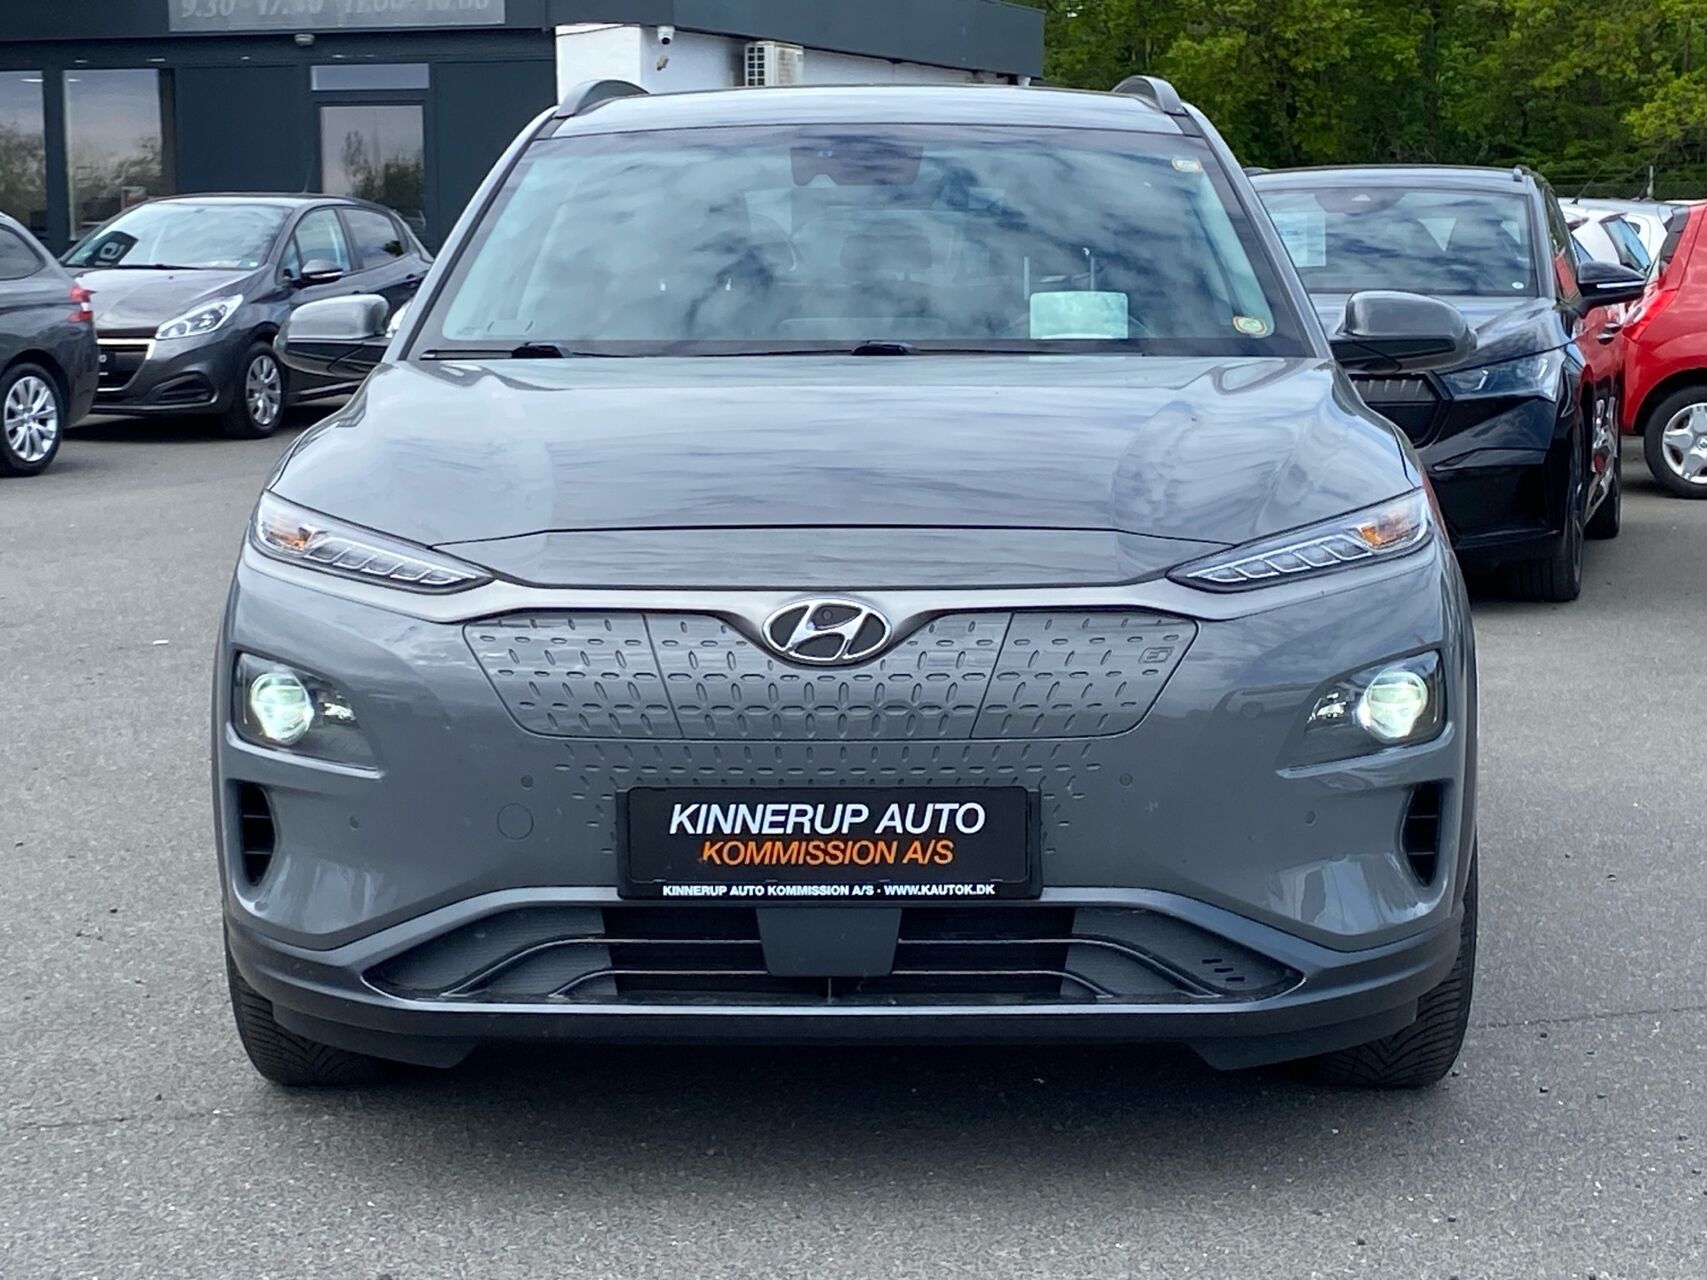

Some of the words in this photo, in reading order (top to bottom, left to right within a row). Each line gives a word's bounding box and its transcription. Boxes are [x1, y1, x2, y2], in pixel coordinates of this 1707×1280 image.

[668, 803, 870, 835] KINNERUP
[874, 802, 986, 835] AUTO
[702, 840, 898, 866] KOMMISSION
[902, 839, 955, 866] A/S
[662, 885, 728, 897] KINNERUP
[729, 885, 765, 896] AUTO
[767, 884, 850, 896] KOMMISSION
[851, 884, 875, 896] A/S
[883, 884, 996, 896] WWW.KAUTOK.DK
